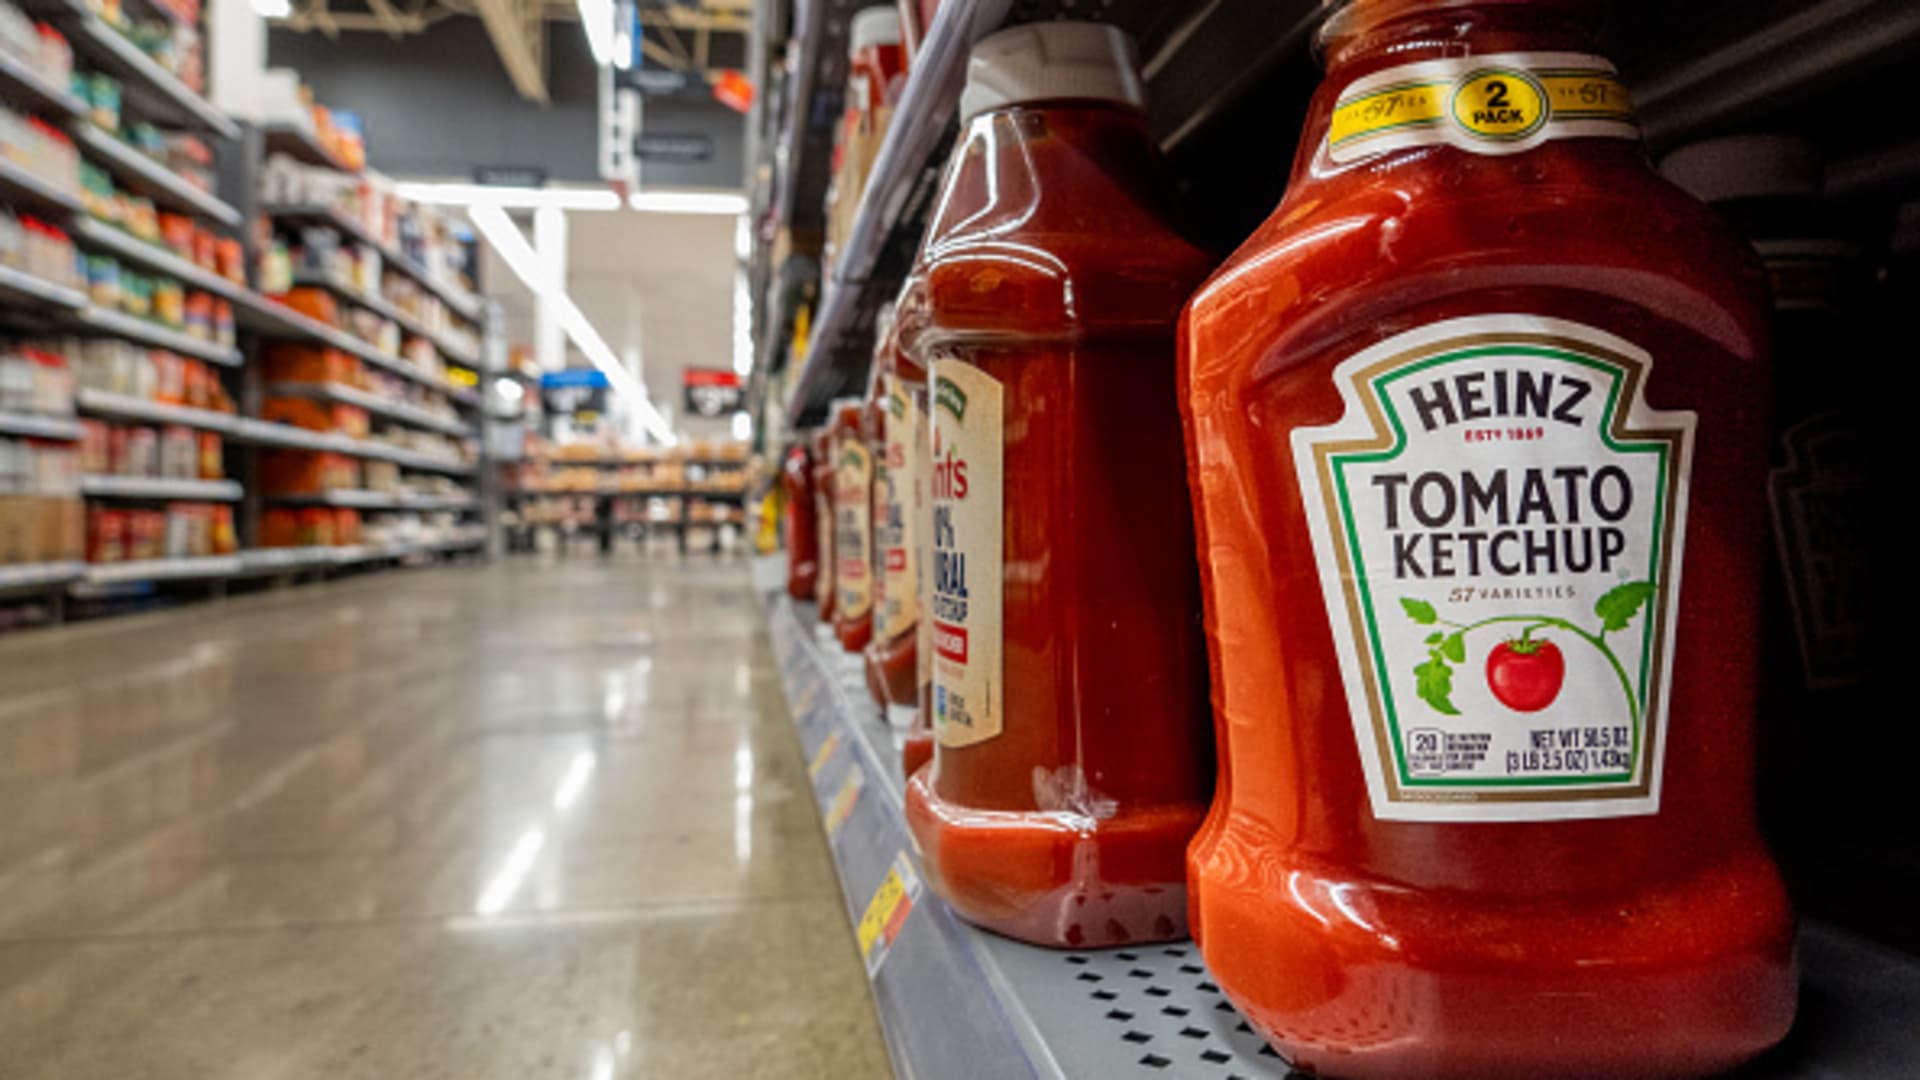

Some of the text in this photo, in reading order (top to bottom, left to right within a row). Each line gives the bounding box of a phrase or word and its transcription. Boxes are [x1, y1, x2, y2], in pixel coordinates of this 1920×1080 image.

[1485, 81, 1510, 108] 2
[1472, 109, 1524, 125] PACK
[1408, 370, 1592, 432] HEINZ
[1507, 425, 1544, 441] 1869
[1371, 464, 1634, 530] TOMATO
[1393, 527, 1626, 579] KETCHUP
[1448, 584, 1576, 604] 57 VARIETIES
[1530, 729, 1555, 749] NET
[1558, 728, 1580, 748] WT
[1506, 749, 1520, 774] (3
[1523, 749, 1539, 770] LB
[1542, 749, 1563, 770] 2.5
[1565, 748, 1588, 773] OZ)
